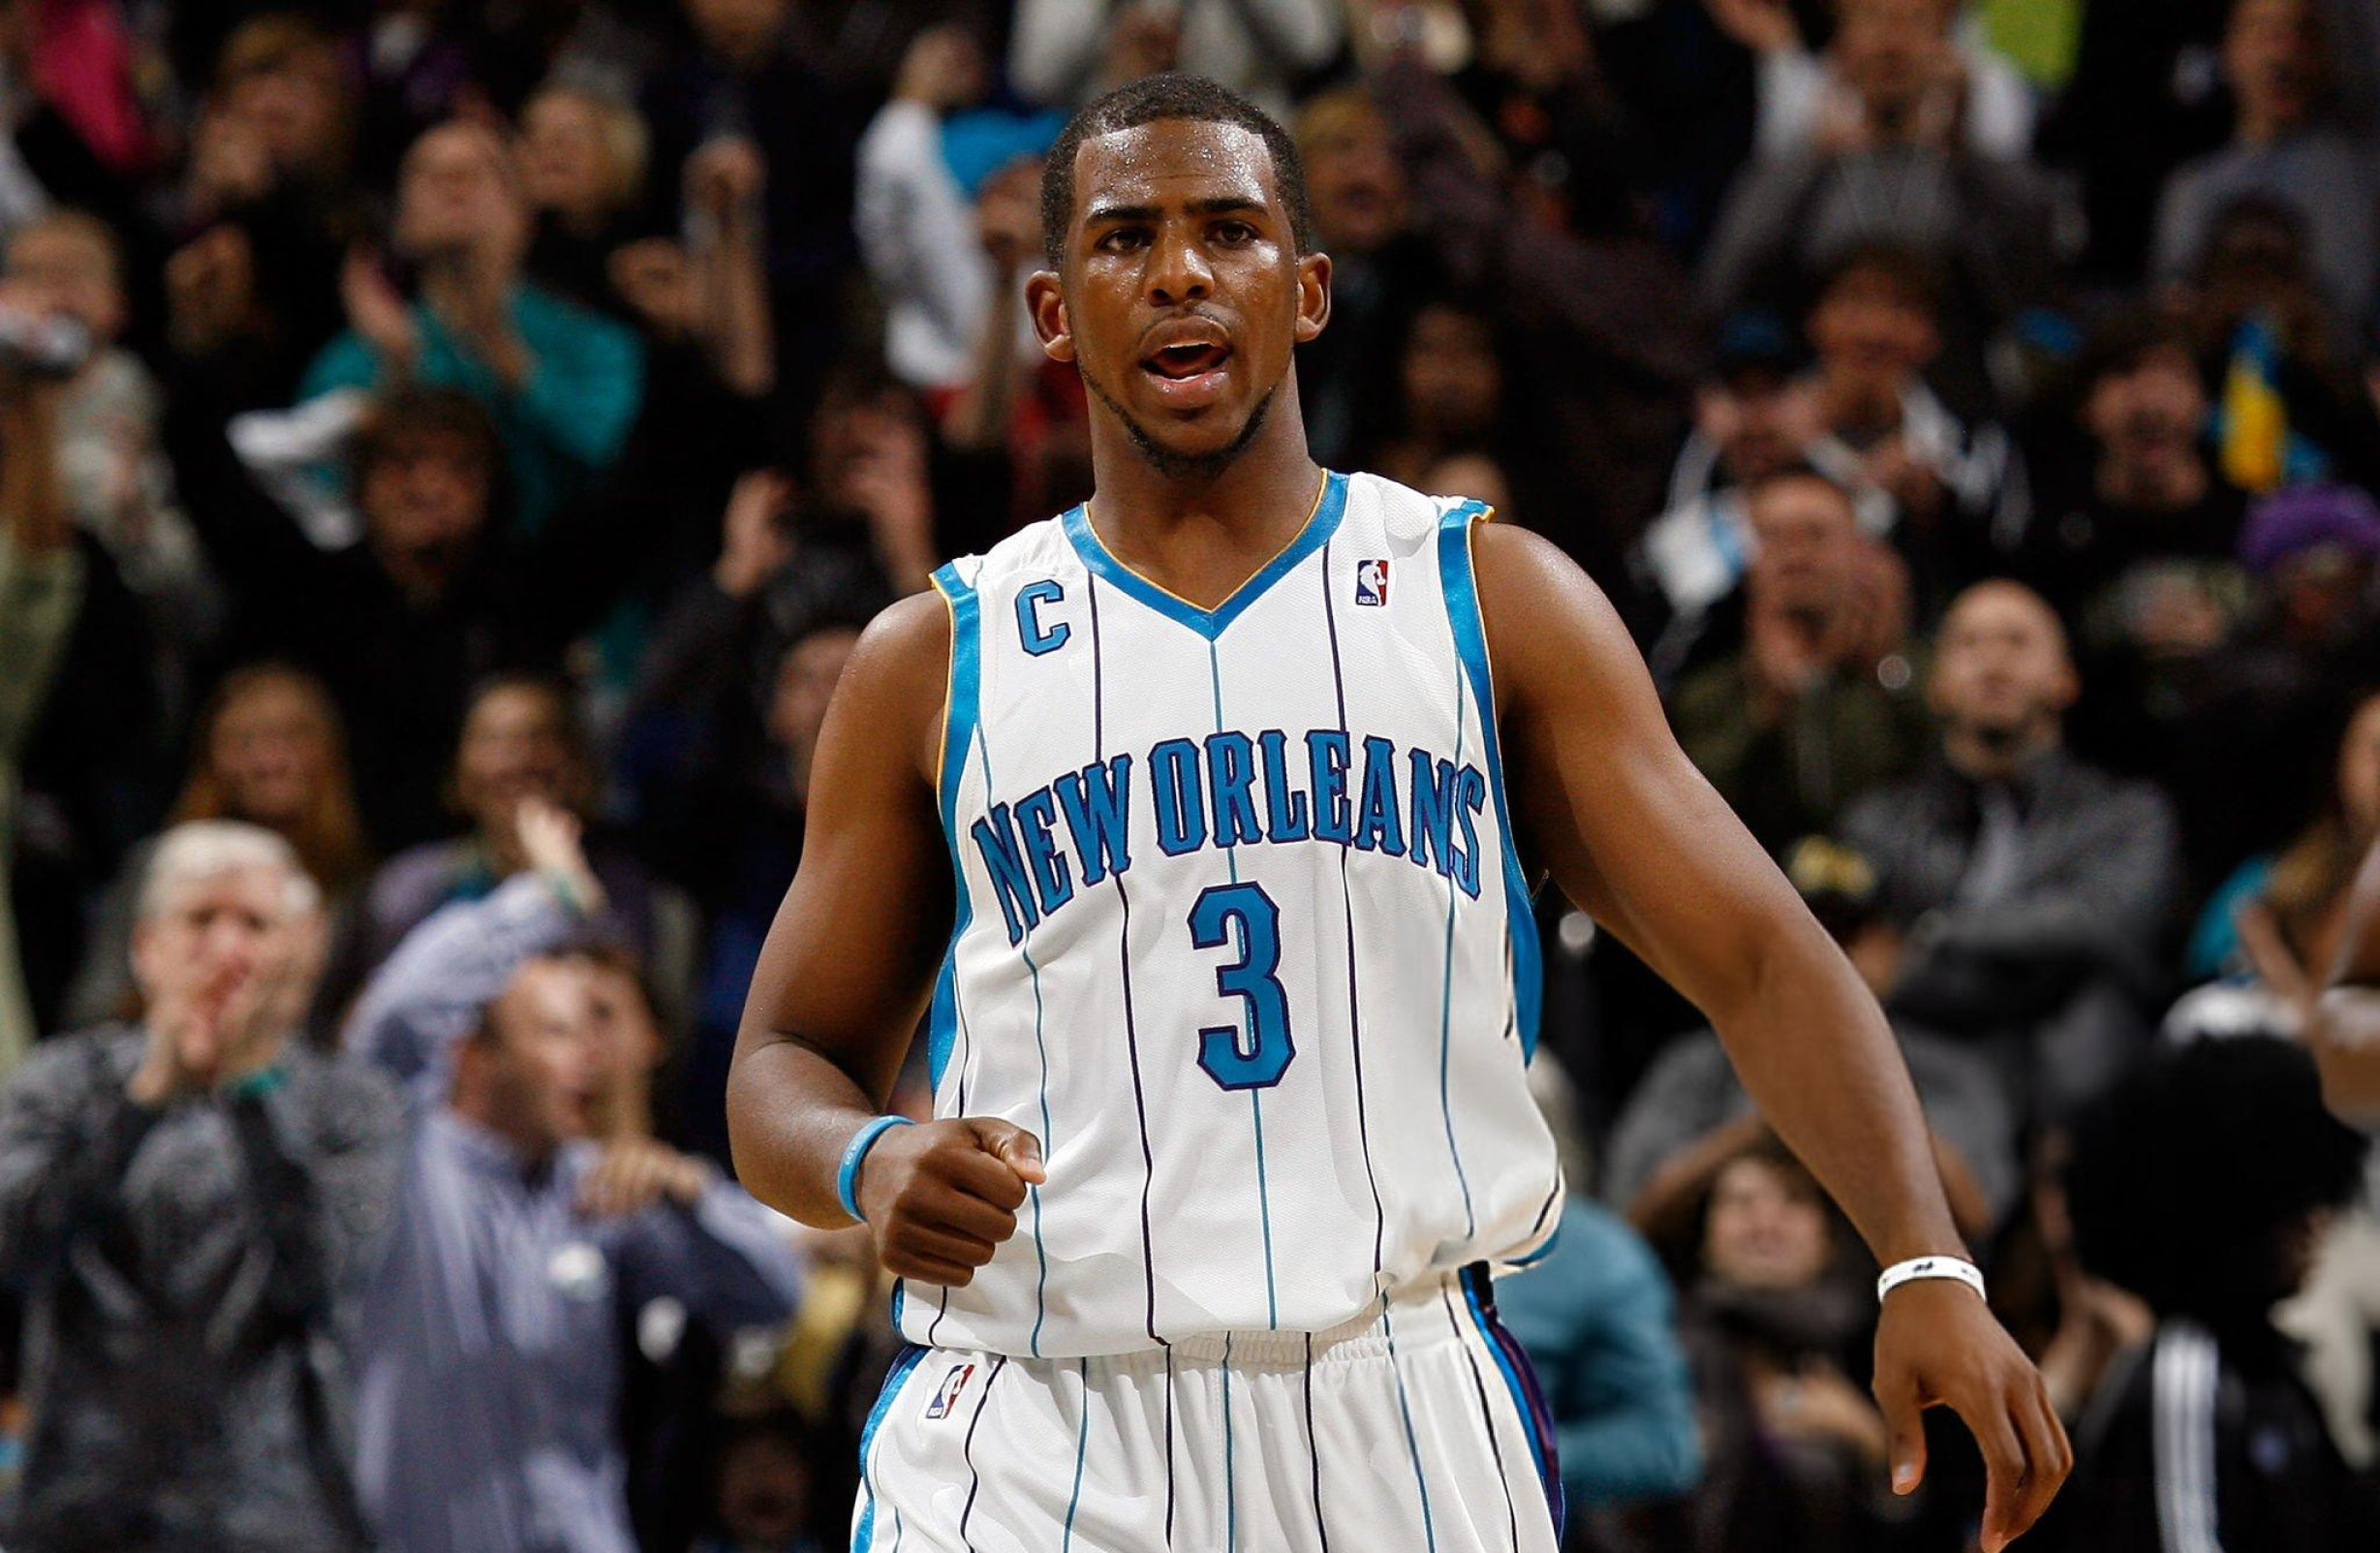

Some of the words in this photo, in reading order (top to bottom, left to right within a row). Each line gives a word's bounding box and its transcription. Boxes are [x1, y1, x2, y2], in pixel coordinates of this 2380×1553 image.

[1015, 579, 1070, 656] C
[971, 753, 1132, 947] NEW
[1148, 730, 1486, 901] ORLEANS
[1187, 882, 1296, 1090] 3
